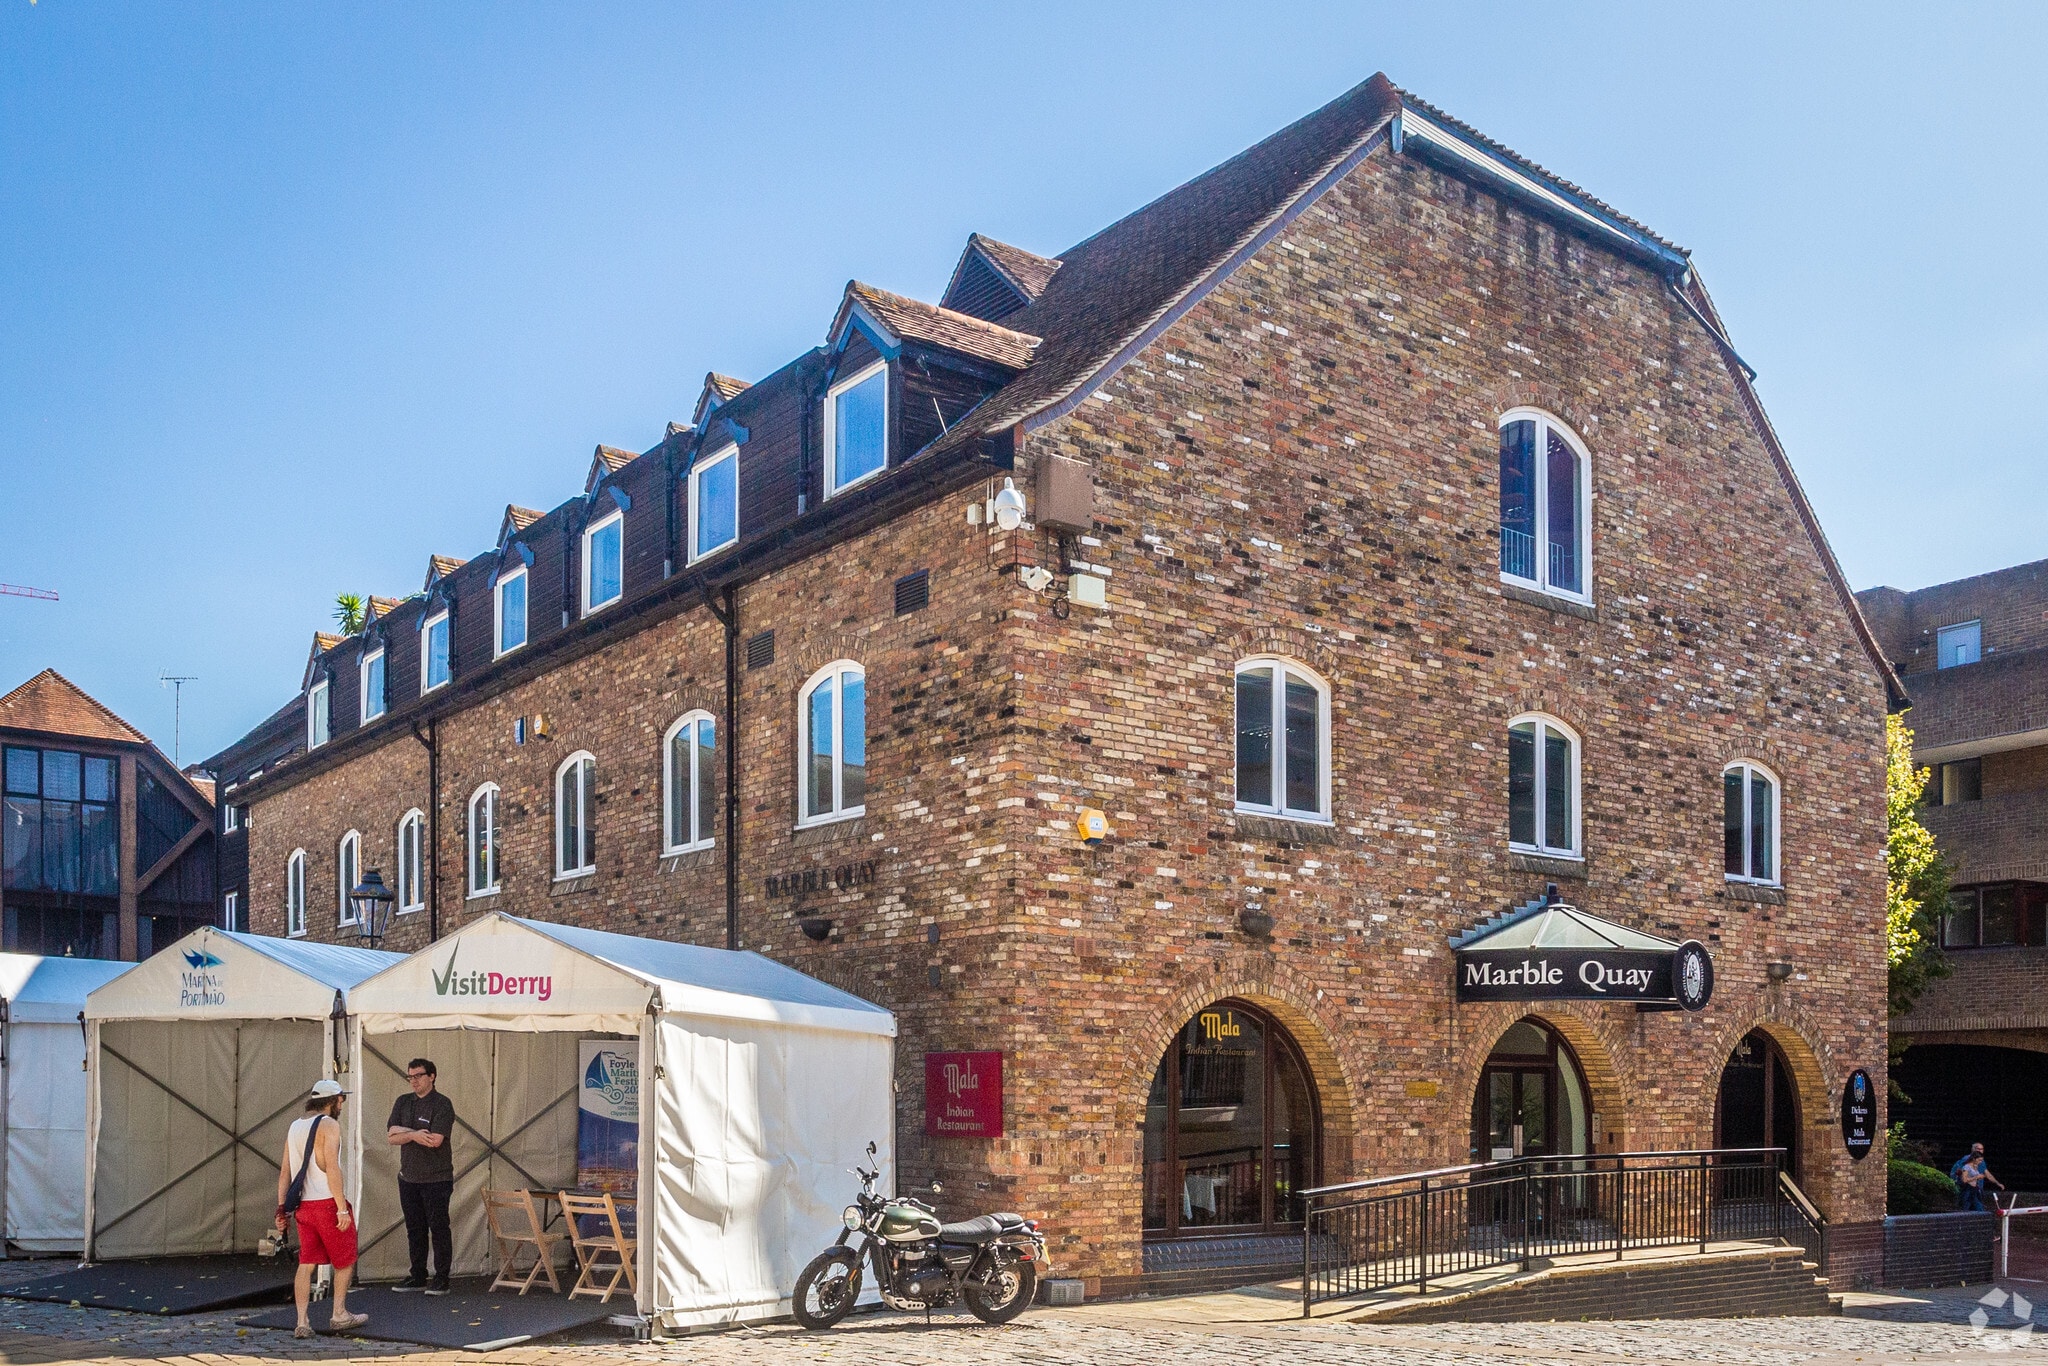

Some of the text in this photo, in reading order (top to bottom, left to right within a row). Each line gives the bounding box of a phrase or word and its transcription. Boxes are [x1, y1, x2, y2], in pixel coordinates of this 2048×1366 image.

[836, 860, 877, 892] QUAY
[432, 936, 551, 1001] VisitDerry
[1464, 960, 1563, 986] Marble
[1579, 961, 1652, 992] Quay
[1200, 1011, 1240, 1041] Mala
[1185, 1043, 1256, 1056] Indian Restaurant
[610, 1060, 635, 1070] Foyle
[615, 1077, 638, 1086] Festi
[943, 1059, 979, 1098] Mala
[947, 1102, 974, 1117] Indian
[937, 1117, 984, 1130] Restaurant
